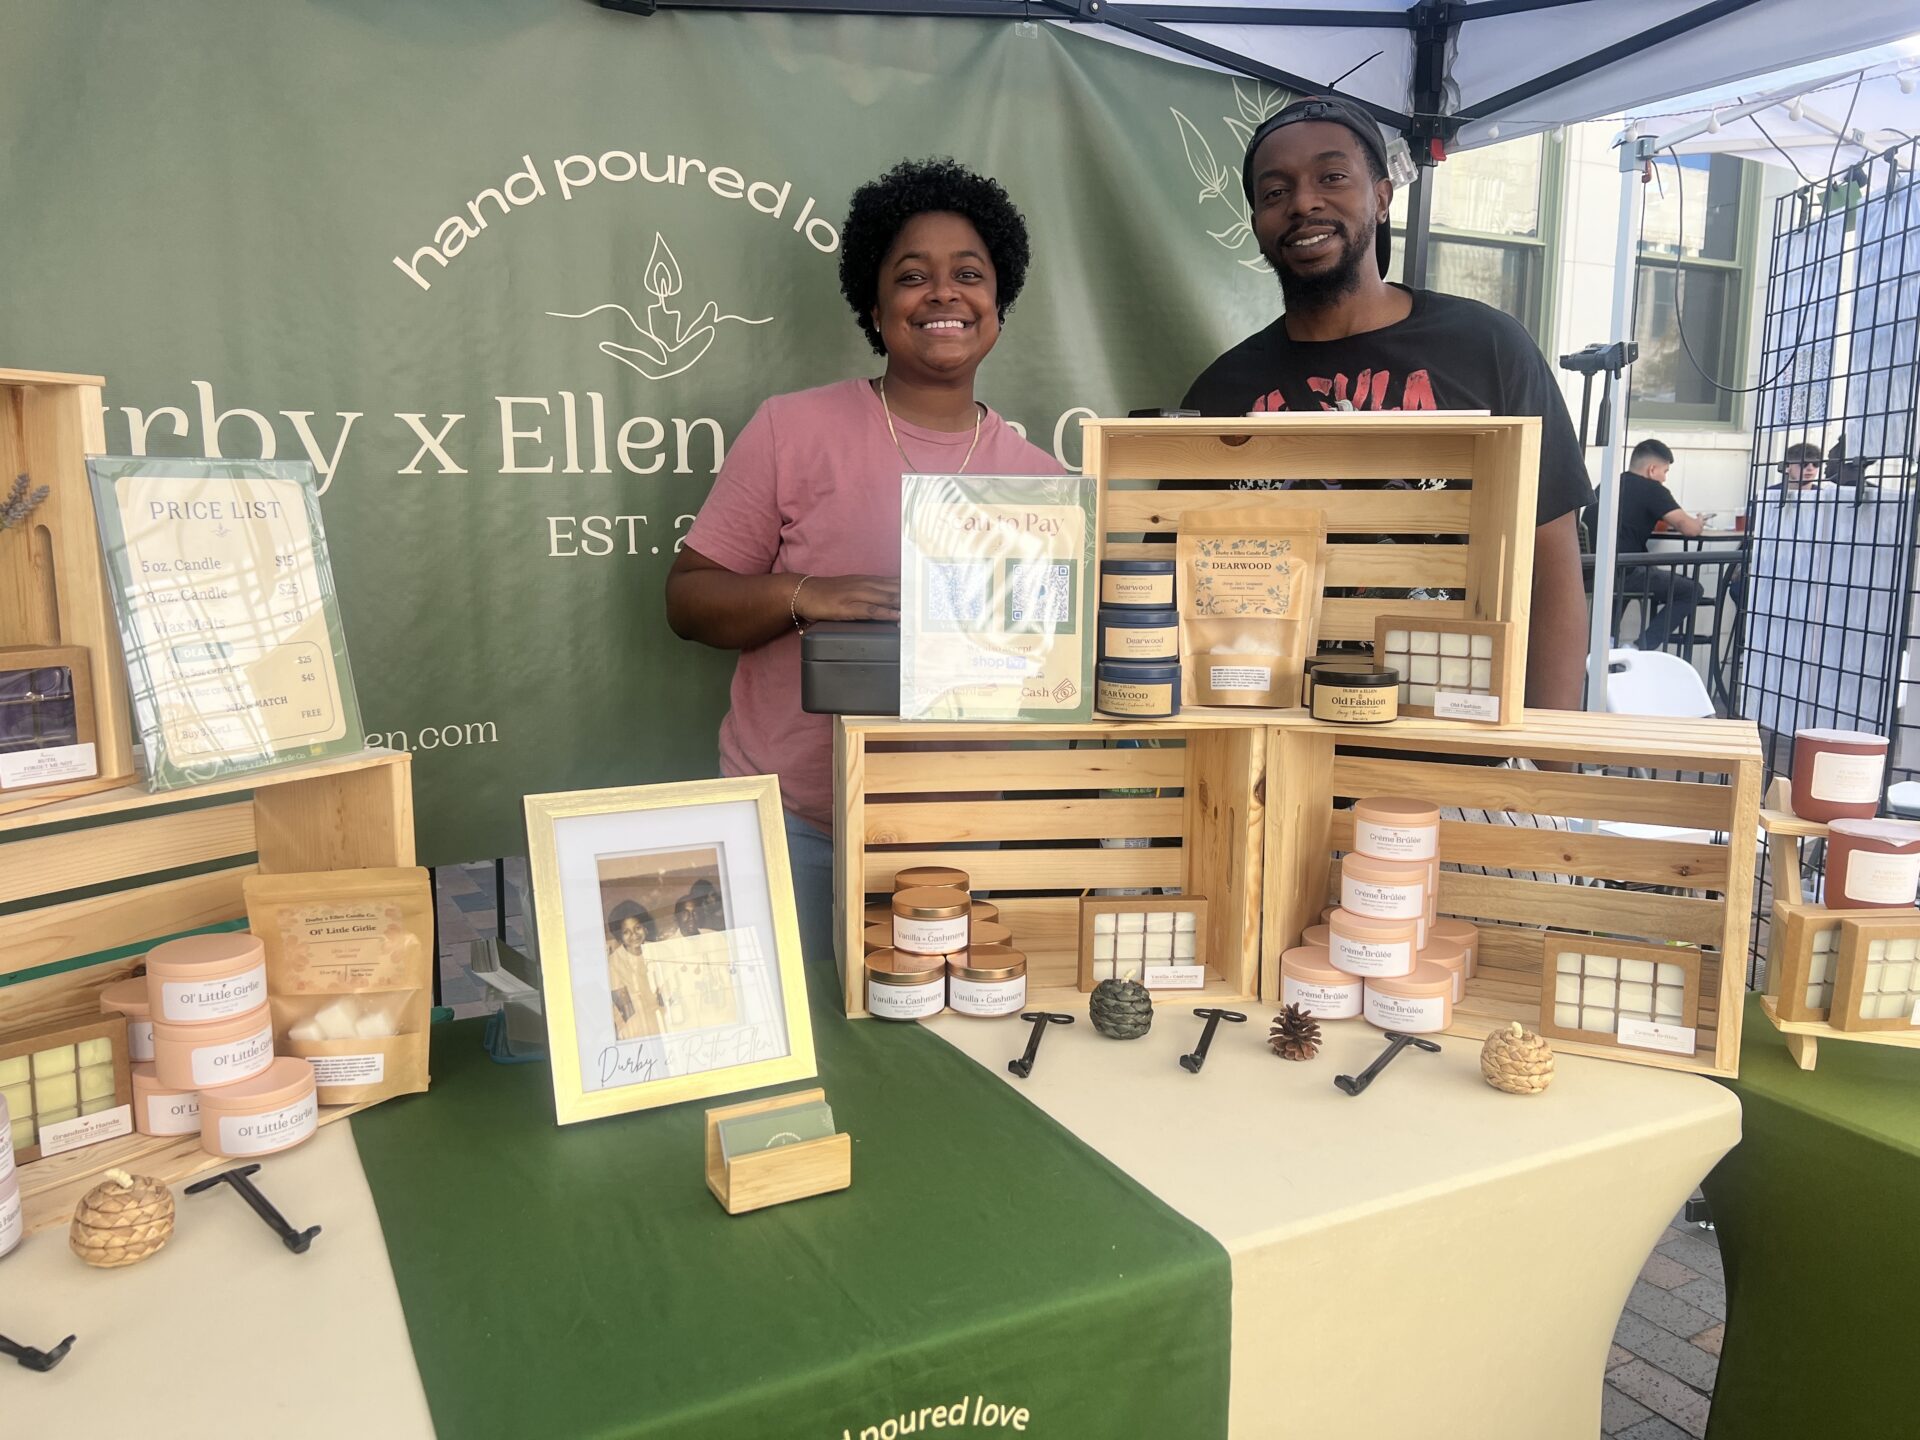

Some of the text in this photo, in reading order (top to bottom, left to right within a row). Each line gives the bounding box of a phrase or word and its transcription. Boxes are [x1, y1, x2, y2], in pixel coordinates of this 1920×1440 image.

[393, 150, 840, 291] hand poured lo
[92, 380, 725, 497] rby x Ellen
[150, 501, 282, 520] PRICE LIST
[1026, 513, 1064, 537] Pay
[546, 515, 659, 557] EST.
[142, 555, 294, 572] 5 oz. Candle $15
[1212, 562, 1272, 570] DEARWOOD
[180, 587, 228, 601] Candle
[279, 584, 298, 595] $25
[1126, 637, 1164, 645] Dearwood
[298, 656, 312, 664] $25
[302, 673, 316, 682] $45
[1021, 687, 1049, 698] Cash
[1101, 689, 1149, 699] DEARWOOD
[255, 696, 288, 708] MATCH
[1332, 697, 1347, 705] Old
[301, 708, 322, 719] FREE
[364, 721, 499, 752] en.com
[326, 926, 350, 934] Little
[897, 931, 920, 941] Vanilla
[927, 931, 965, 942] Cashmere
[180, 981, 260, 1003] Ol' Little Girlie
[872, 993, 898, 1005] Vanilla
[905, 992, 942, 1005] Cashmere
[954, 992, 979, 1003] Vanilla
[986, 992, 1022, 1004] Cashmere
[213, 1055, 229, 1066] Ol'
[232, 1045, 259, 1063] Little
[598, 1044, 658, 1088] Durby
[171, 1105, 186, 1116] Ol'
[238, 1107, 314, 1137] Ol' Little Girlie
[52, 1126, 95, 1141] Grandma's
[96, 1119, 120, 1129] Hands
[973, 1395, 1031, 1431] love
